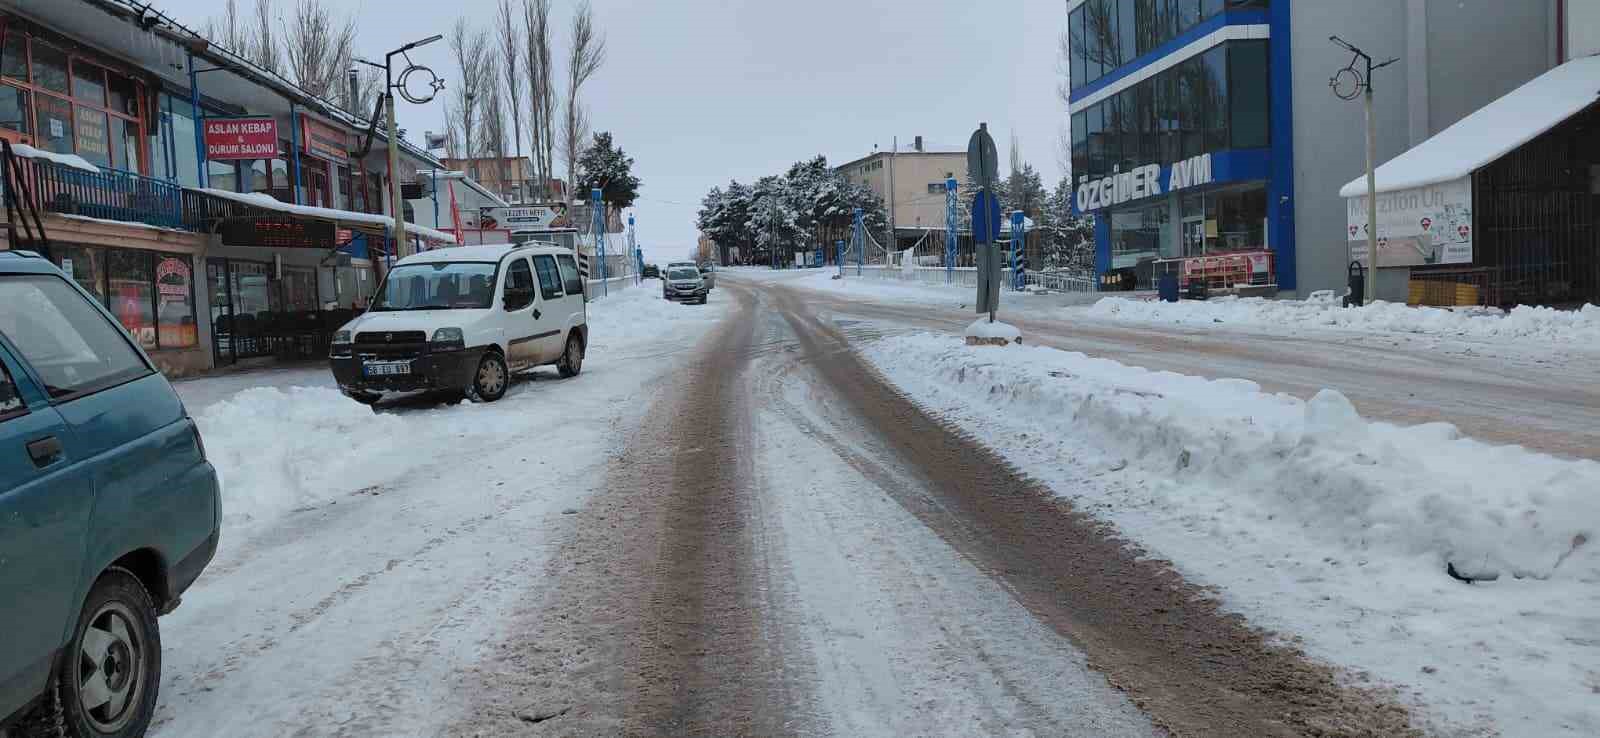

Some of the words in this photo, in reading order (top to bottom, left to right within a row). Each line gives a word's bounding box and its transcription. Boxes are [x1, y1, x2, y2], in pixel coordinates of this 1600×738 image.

[208, 123, 239, 134] ASLAN
[241, 122, 272, 134] KEBAP
[240, 143, 273, 153] SALONU
[1077, 163, 1161, 212] ÖZGİDER
[1169, 153, 1211, 192] AVM
